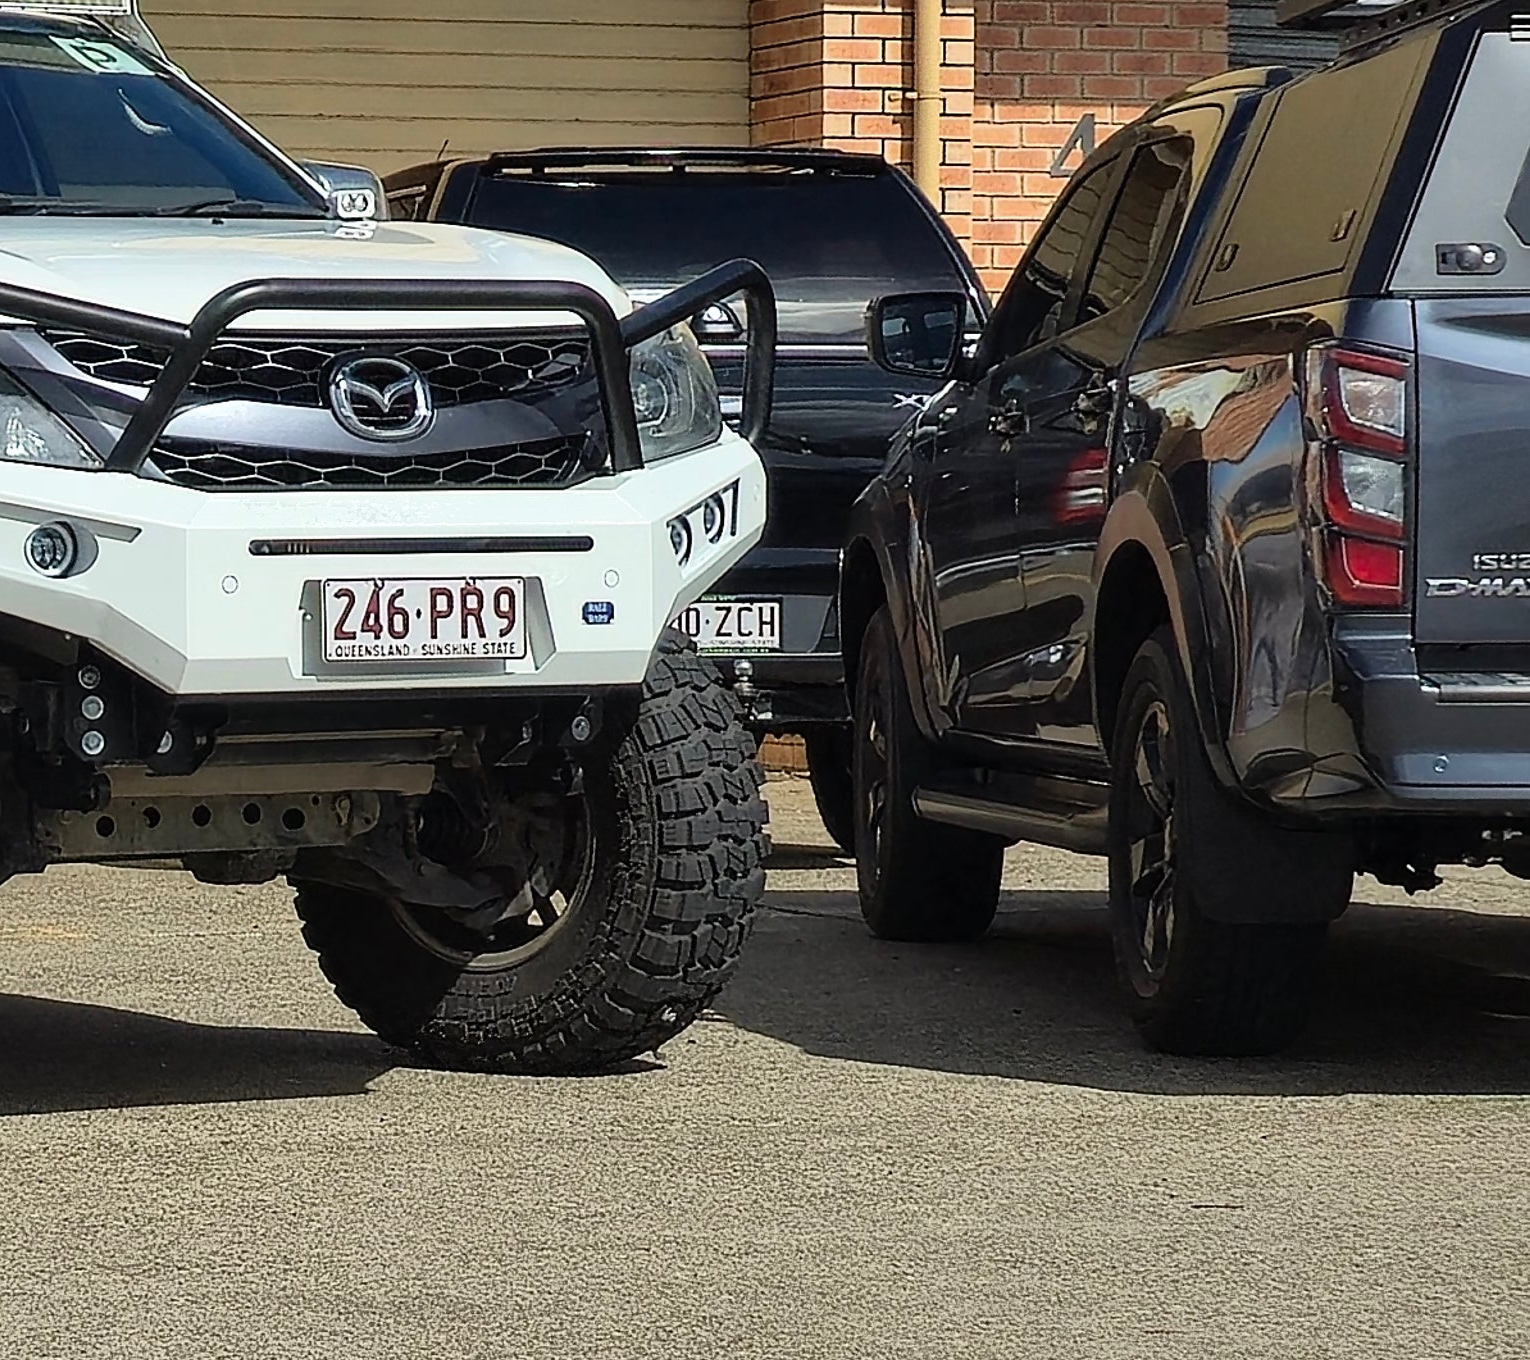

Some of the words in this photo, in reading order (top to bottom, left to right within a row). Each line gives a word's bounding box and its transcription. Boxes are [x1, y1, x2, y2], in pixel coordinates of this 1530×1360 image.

[1425, 577, 1530, 597] D-MA
[335, 643, 410, 657] QUEENSLAND
[421, 642, 478, 656] SUNSHINE
[482, 641, 516, 655] STATE
